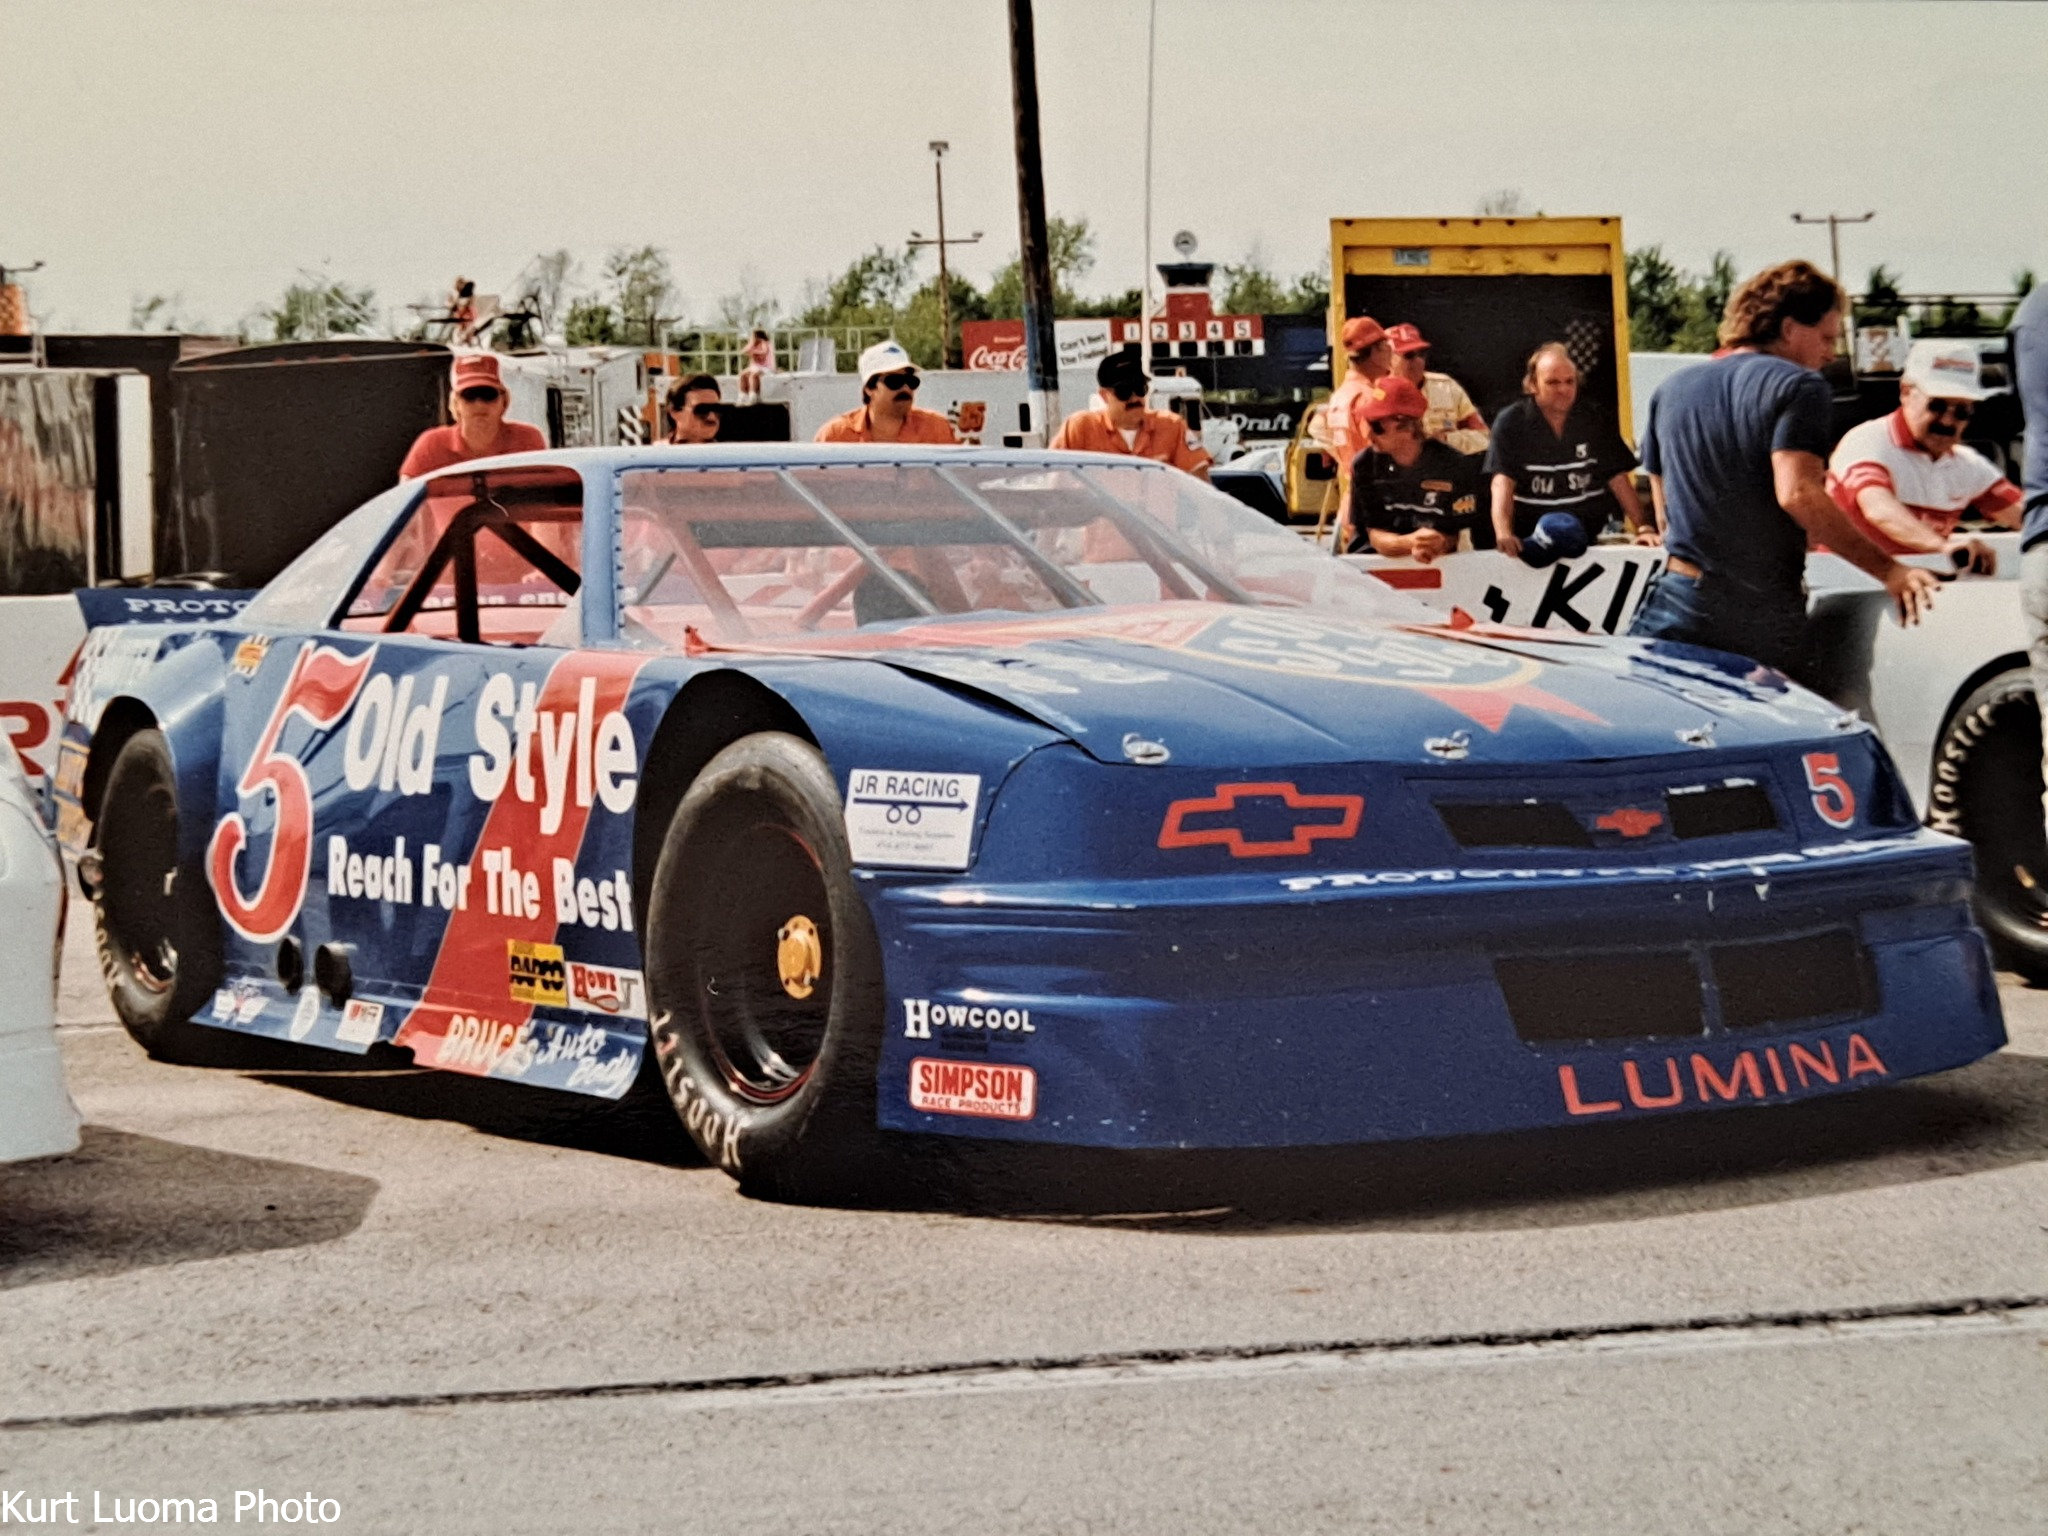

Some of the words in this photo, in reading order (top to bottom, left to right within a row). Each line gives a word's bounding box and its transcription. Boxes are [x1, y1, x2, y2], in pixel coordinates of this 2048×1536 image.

[1155, 325, 1165, 337] 2
[1183, 324, 1192, 338] 3
[1209, 322, 1219, 332] 4
[1575, 442, 1588, 459] 5
[343, 672, 450, 796] Old
[469, 672, 638, 836] Style
[206, 640, 380, 944] 5
[855, 775, 878, 794] JR
[885, 776, 960, 798] RACING
[1800, 751, 1856, 831] 5
[328, 835, 412, 905] Reach
[422, 843, 472, 912] For
[482, 849, 541, 921] The
[553, 857, 635, 932] Best
[919, 1064, 1023, 1102] SIMPSON
[1558, 1033, 1888, 1116] LUMINA
[921, 1096, 952, 1108] RACE
[958, 1099, 1022, 1114] PRODUCTS
